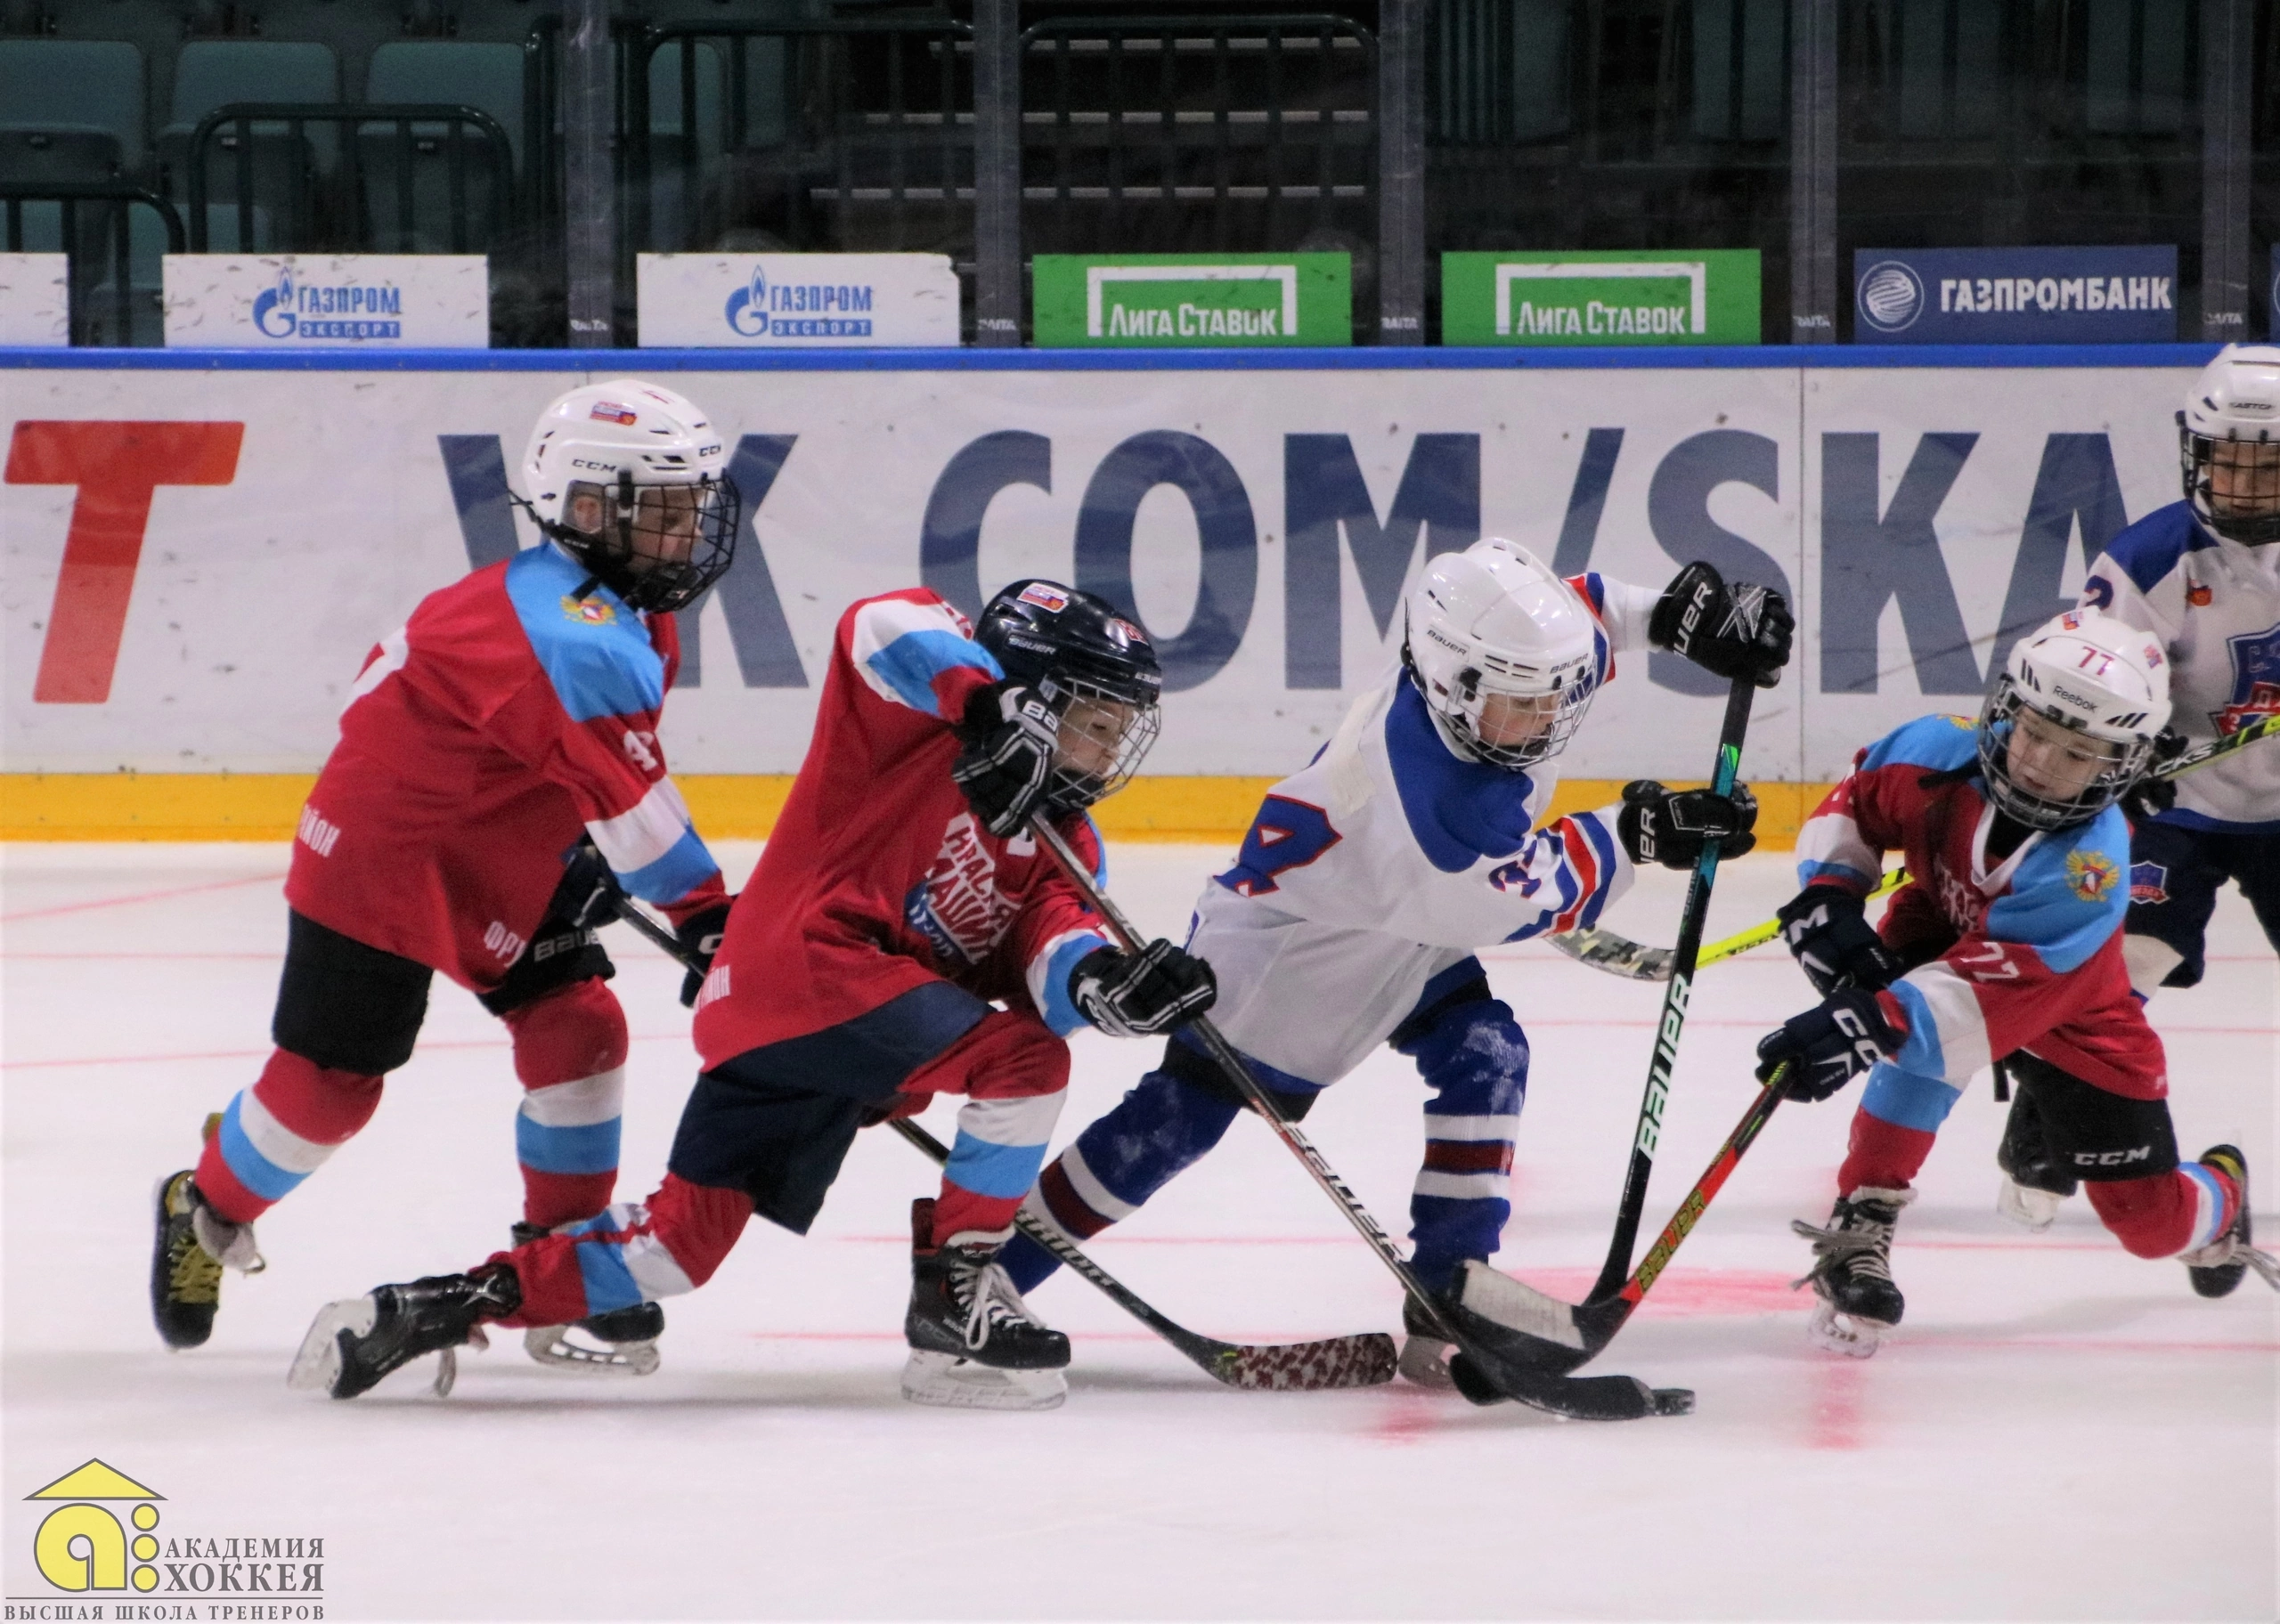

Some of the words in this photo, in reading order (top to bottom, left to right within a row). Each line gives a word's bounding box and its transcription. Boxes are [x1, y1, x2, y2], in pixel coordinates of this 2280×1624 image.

[298, 287, 401, 313] ГАЗПРОМ
[770, 286, 872, 312] ГАЗПРОМ
[1940, 277, 2172, 313] ГАЗПРОМБАНК
[301, 323, 399, 337] ЭКСПОРТ
[773, 321, 870, 335] ЭКСПОРТ
[572, 459, 617, 473] CCM
[1673, 581, 1714, 659] UER
[1008, 633, 1057, 655] BAUER
[1427, 629, 1468, 656] BAUER
[1550, 653, 1589, 674] BAUER
[2078, 646, 2115, 677] 77
[2053, 685, 2099, 713] Reebok
[2148, 743, 2214, 777] CKS
[1958, 941, 2021, 982] 77
[1636, 971, 1691, 1162] BAUER
[2074, 1146, 2151, 1166] CCM
[1279, 1121, 1413, 1263] BAUER
[1634, 1189, 1707, 1295] BAUER
